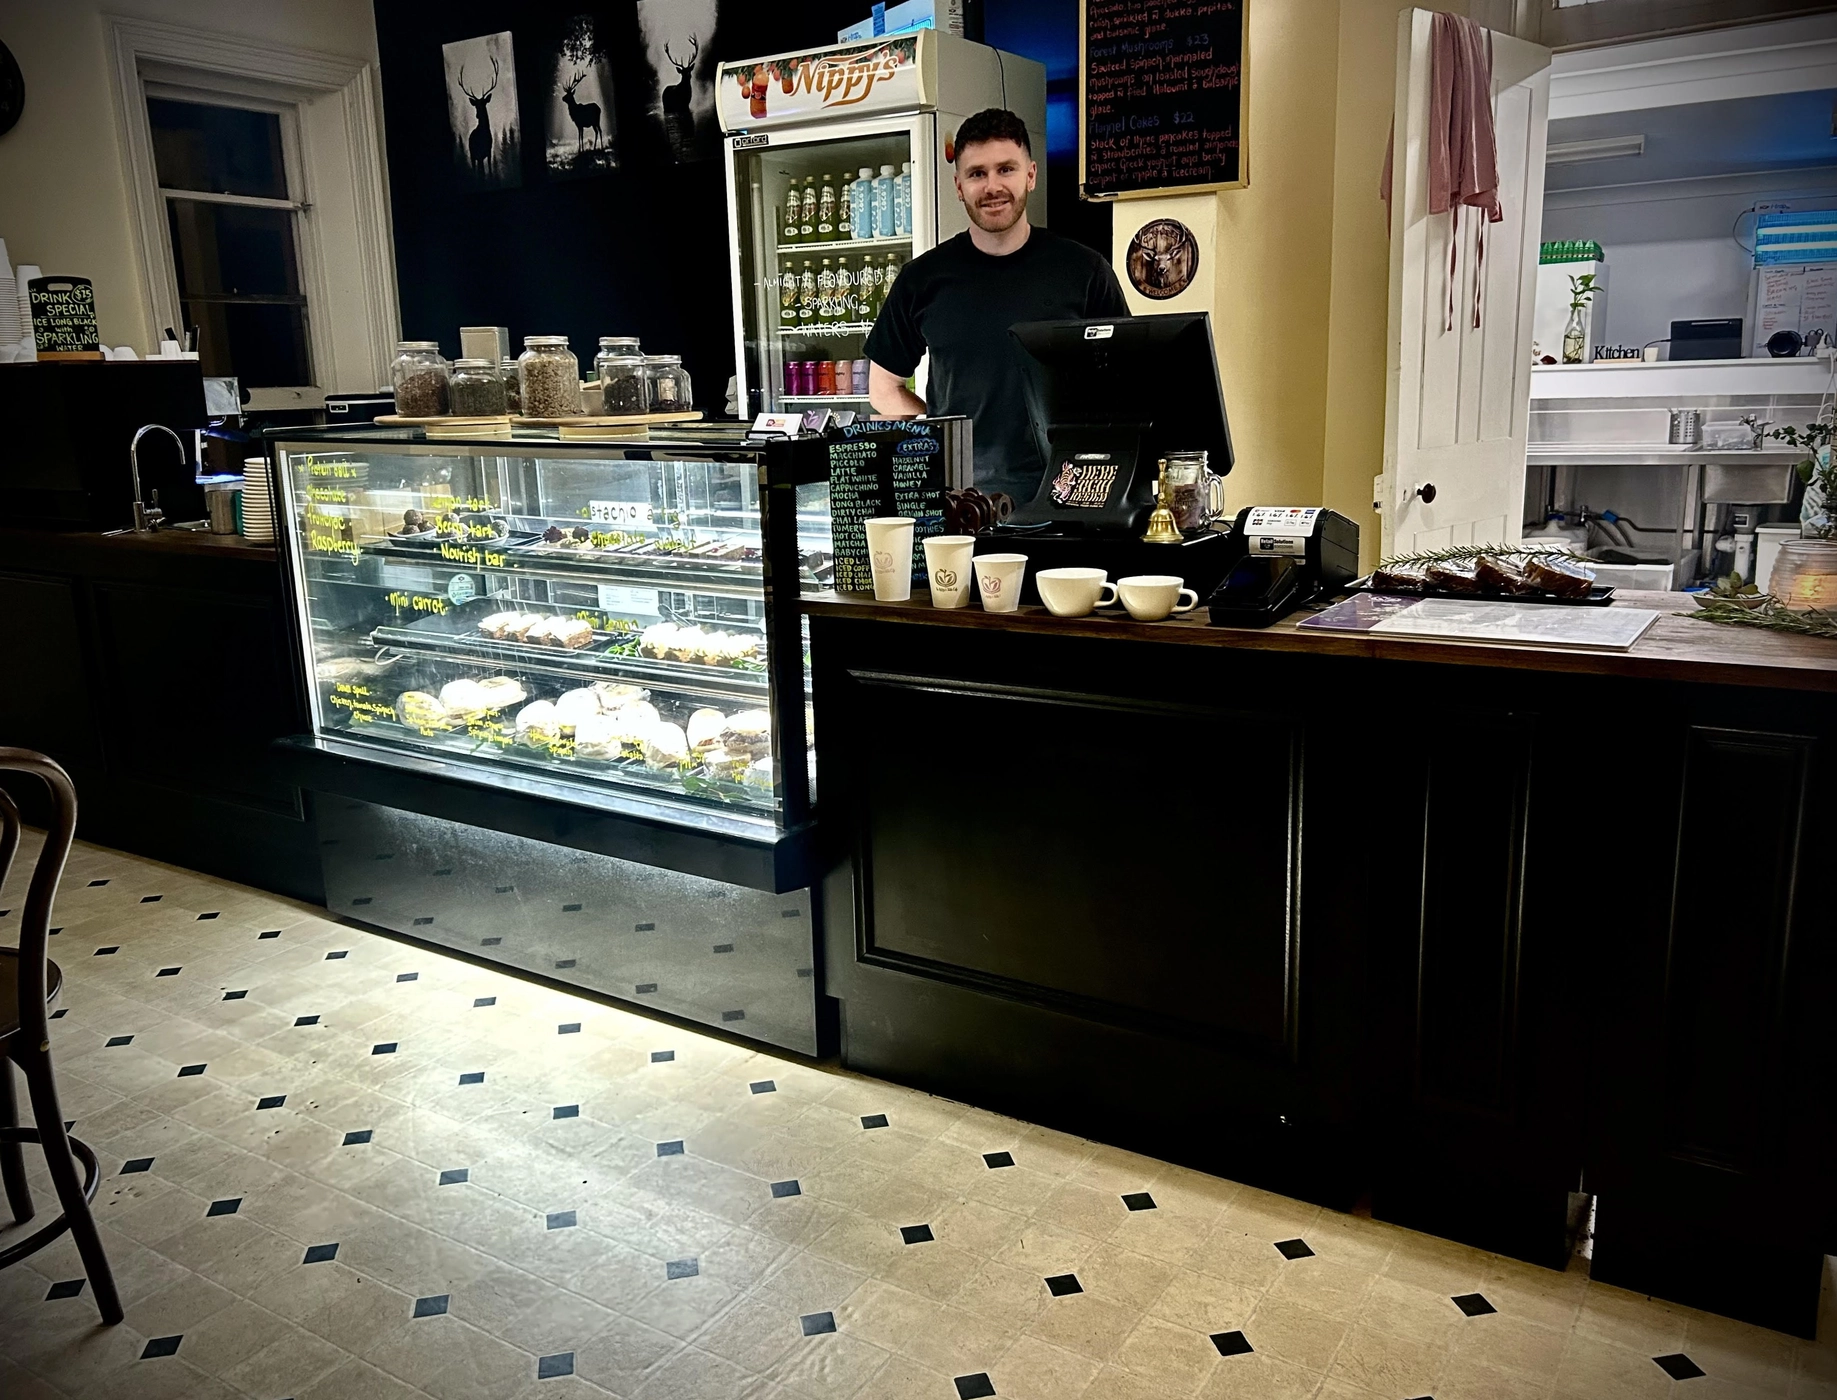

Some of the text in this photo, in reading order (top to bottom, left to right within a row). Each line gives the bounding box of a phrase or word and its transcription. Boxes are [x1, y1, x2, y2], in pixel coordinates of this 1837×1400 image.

[1122, 39, 1174, 55] Mushrooms
[1186, 34, 1209, 46] $23
[788, 50, 899, 109] Nippy's
[1088, 90, 1114, 102] topped
[1130, 115, 1160, 130] Cakes
[1173, 111, 1195, 124] $22
[1120, 137, 1130, 146] of
[1202, 124, 1232, 139] topped
[1181, 155, 1198, 166] and
[818, 270, 882, 288] FLAVOURED
[32, 292, 72, 304] DRINK
[804, 294, 858, 310] SPARKLING
[46, 304, 94, 316] SPECIAL
[34, 318, 97, 326] ICE LONG BLACK
[36, 332, 99, 344] SPARKLING
[1594, 344, 1640, 360] Kitchen
[843, 420, 930, 438] DRINKS MENU
[829, 442, 876, 453] ESPRESSO
[903, 442, 934, 451] EXTRAS
[830, 451, 877, 460] MACCHIATO
[830, 460, 864, 468] PICCOLO
[893, 464, 930, 472] CARAMEL
[830, 474, 877, 484] FLAT WHITE
[893, 471, 927, 479] VANILLA
[830, 483, 878, 492] CAPPUCHINO
[893, 480, 921, 488] HONEY
[831, 492, 859, 500] MOCHA
[895, 491, 940, 500] EXTRA SHOT
[831, 499, 881, 508] LONG BLACK
[897, 502, 926, 510] SINGLE
[832, 508, 855, 516] DIRTY
[925, 509, 943, 517] SHOT
[440, 543, 506, 572] Nourish bar
